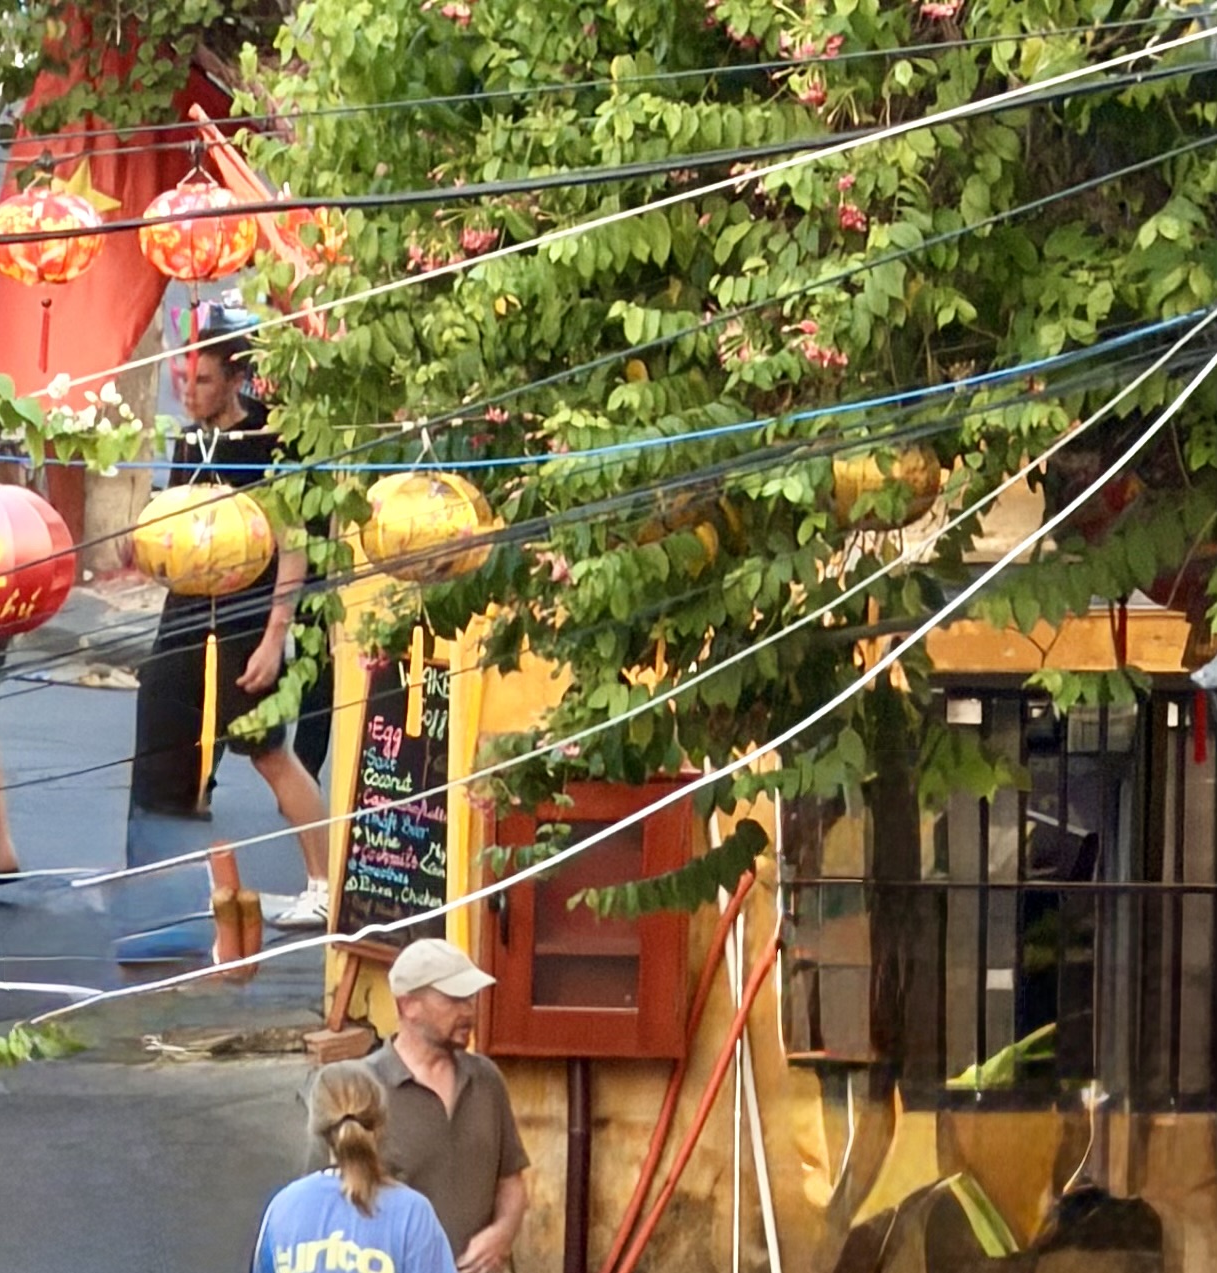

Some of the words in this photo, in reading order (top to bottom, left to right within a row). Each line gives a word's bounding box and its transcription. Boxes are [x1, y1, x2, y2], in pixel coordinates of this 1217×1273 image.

[371, 714, 403, 759] Egg
[363, 767, 414, 793] Coconut
[365, 825, 402, 850] Wine
